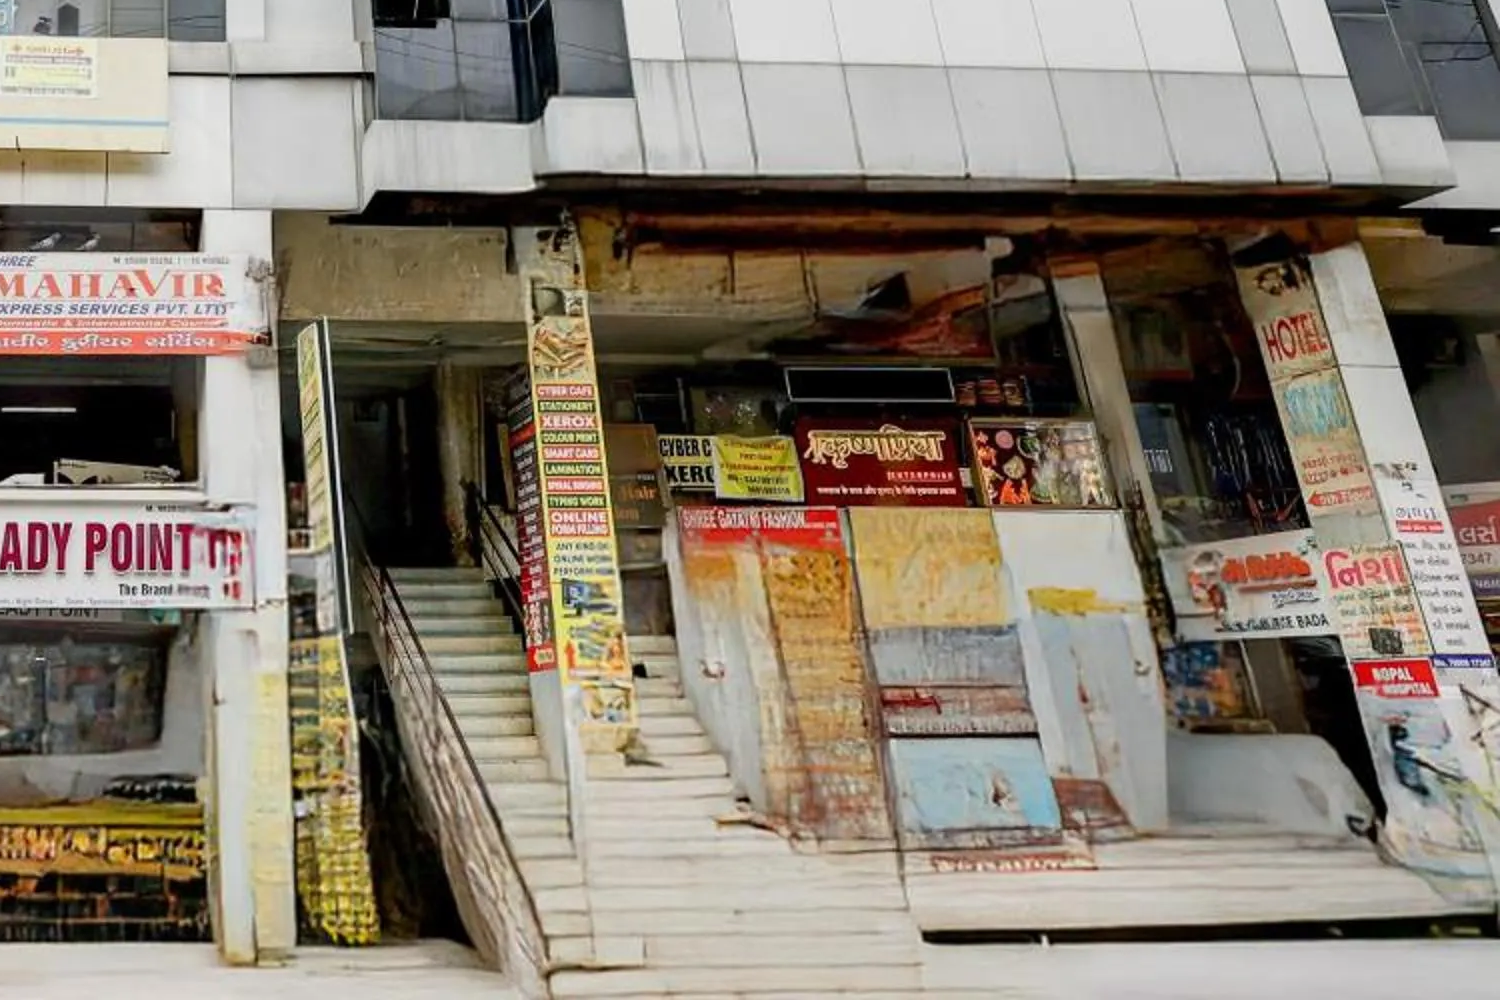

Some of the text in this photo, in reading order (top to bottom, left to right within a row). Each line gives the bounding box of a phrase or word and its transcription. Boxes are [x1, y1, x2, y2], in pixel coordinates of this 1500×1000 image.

[67, 303, 150, 315] SERVICES
[153, 303, 189, 316] PVT.
[1261, 311, 1330, 365] HOTEL
[659, 437, 699, 458] CYBER
[551, 510, 607, 523] ONLINE
[85, 523, 198, 573] POINT
[118, 583, 138, 597] The
